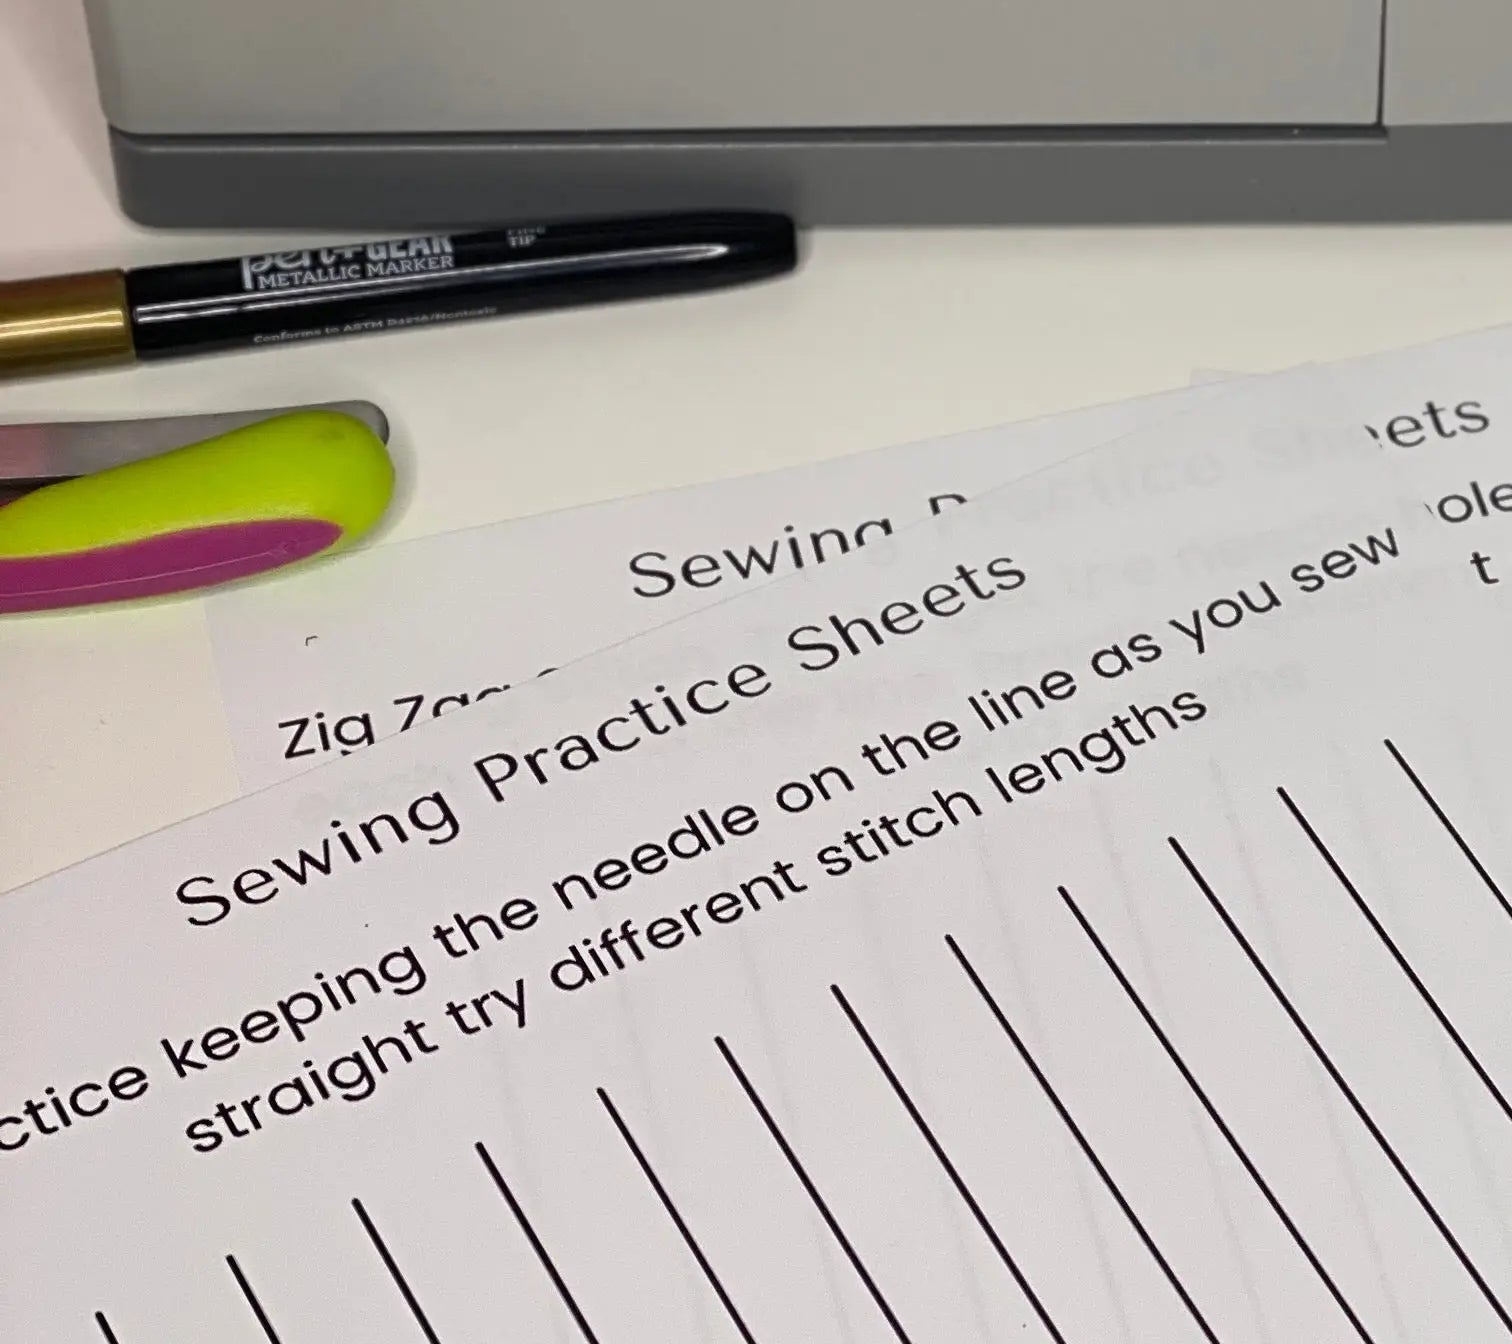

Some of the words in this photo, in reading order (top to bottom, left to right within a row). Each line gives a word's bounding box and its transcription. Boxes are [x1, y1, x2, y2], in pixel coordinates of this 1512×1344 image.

[253, 328, 322, 345] Conforms
[258, 265, 361, 289] METALLIC
[366, 255, 454, 277] MARKER
[1364, 400, 1490, 448] ets
[159, 945, 427, 1079] keeping
[432, 898, 539, 959] the
[551, 804, 760, 911] needle
[775, 765, 856, 814] on
[860, 720, 962, 777] the
[967, 670, 1078, 733] line
[1090, 633, 1163, 679] as
[1167, 580, 1283, 655] you
[1290, 527, 1400, 593] sew
[175, 790, 460, 927] Sewing
[473, 663, 773, 803] Practice
[787, 557, 1027, 672] Sheets
[185, 1019, 440, 1153] straight
[444, 977, 526, 1036] try
[549, 860, 809, 992] different
[816, 789, 984, 877] stitch
[984, 691, 1208, 804] lengths
